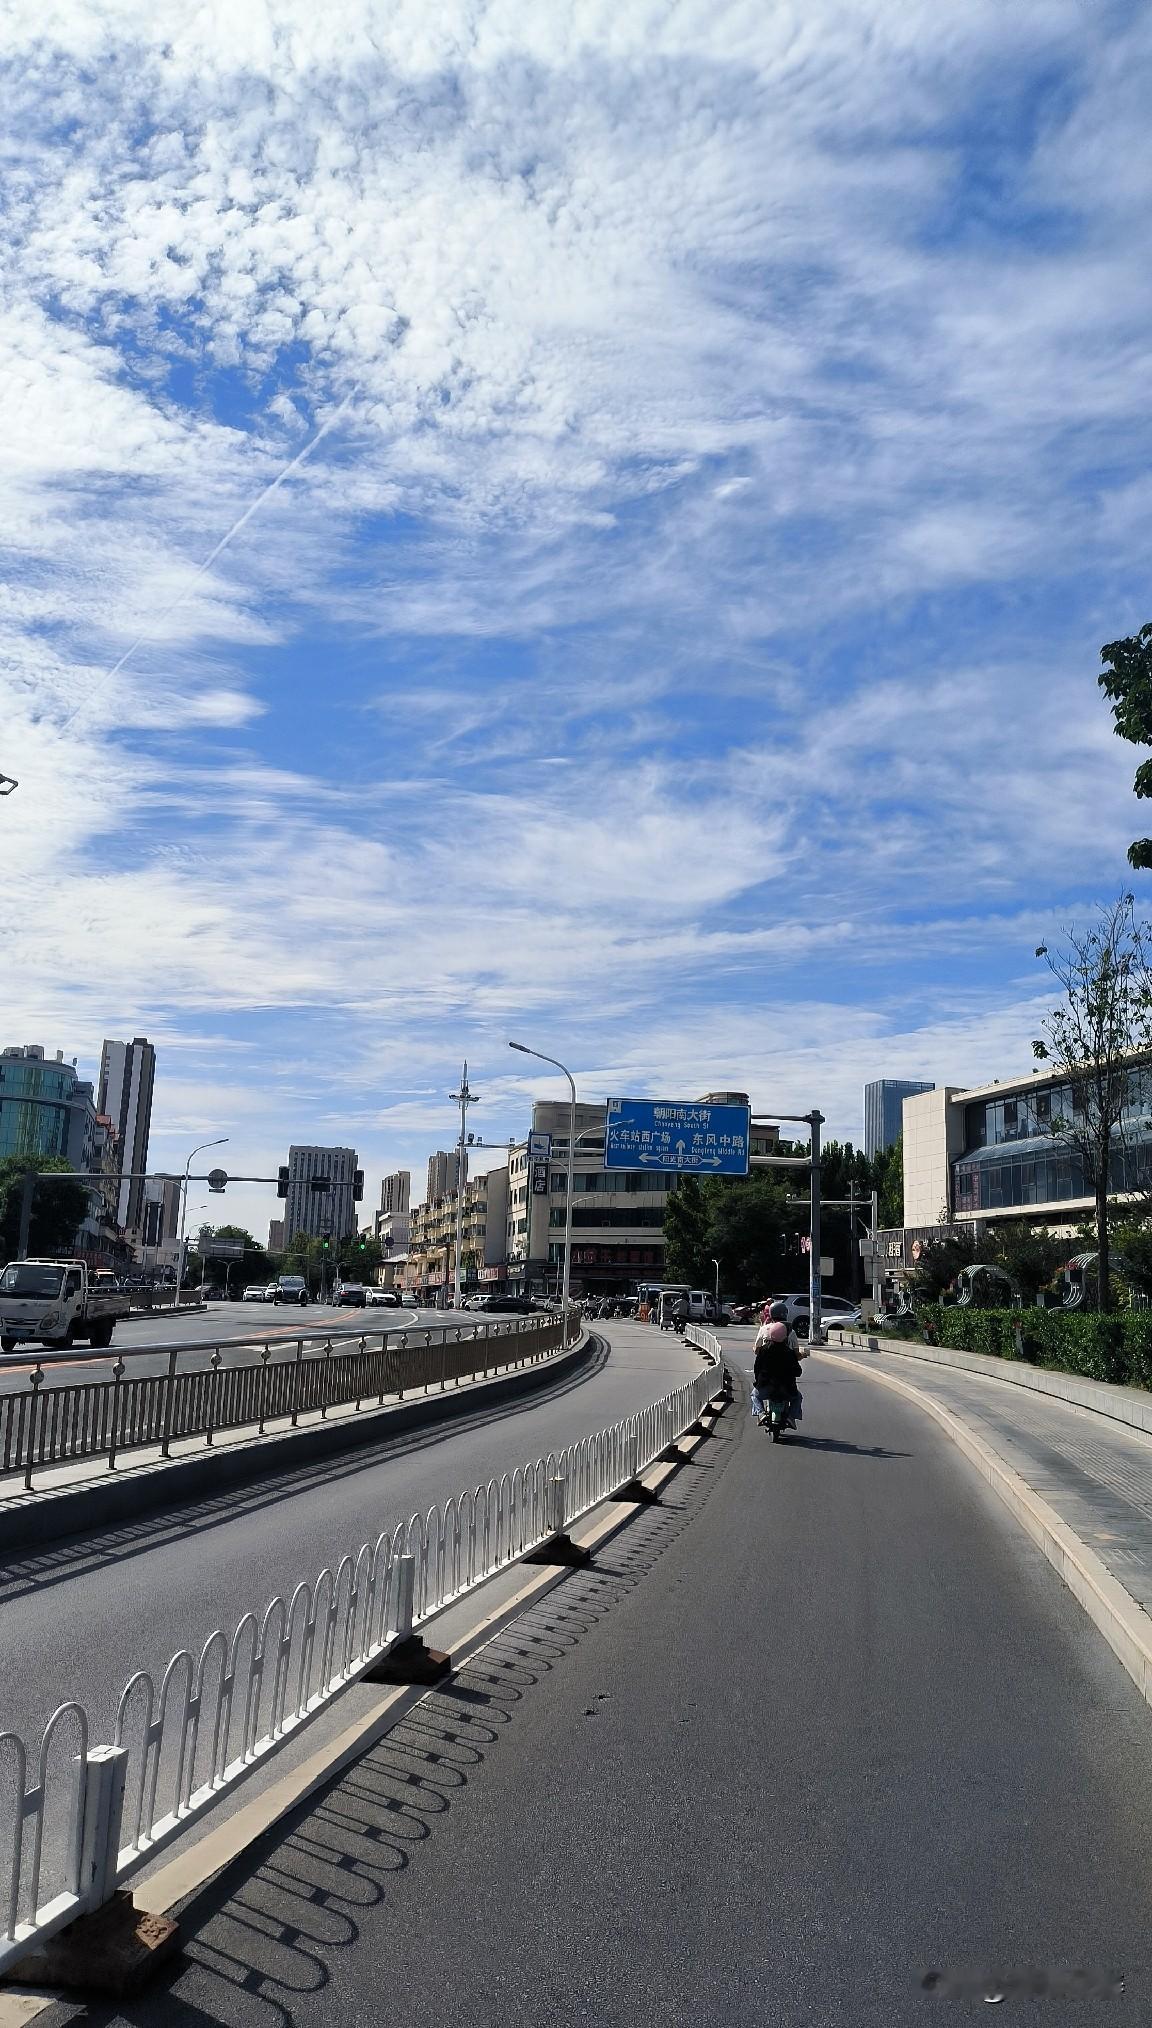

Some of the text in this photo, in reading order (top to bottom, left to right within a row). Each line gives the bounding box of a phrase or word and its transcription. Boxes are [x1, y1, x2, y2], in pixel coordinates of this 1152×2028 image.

[653, 1106, 711, 1122] 朝阳南大街
[610, 1129, 671, 1144] 火车站西广场
[692, 1132, 745, 1148] 东风中路
